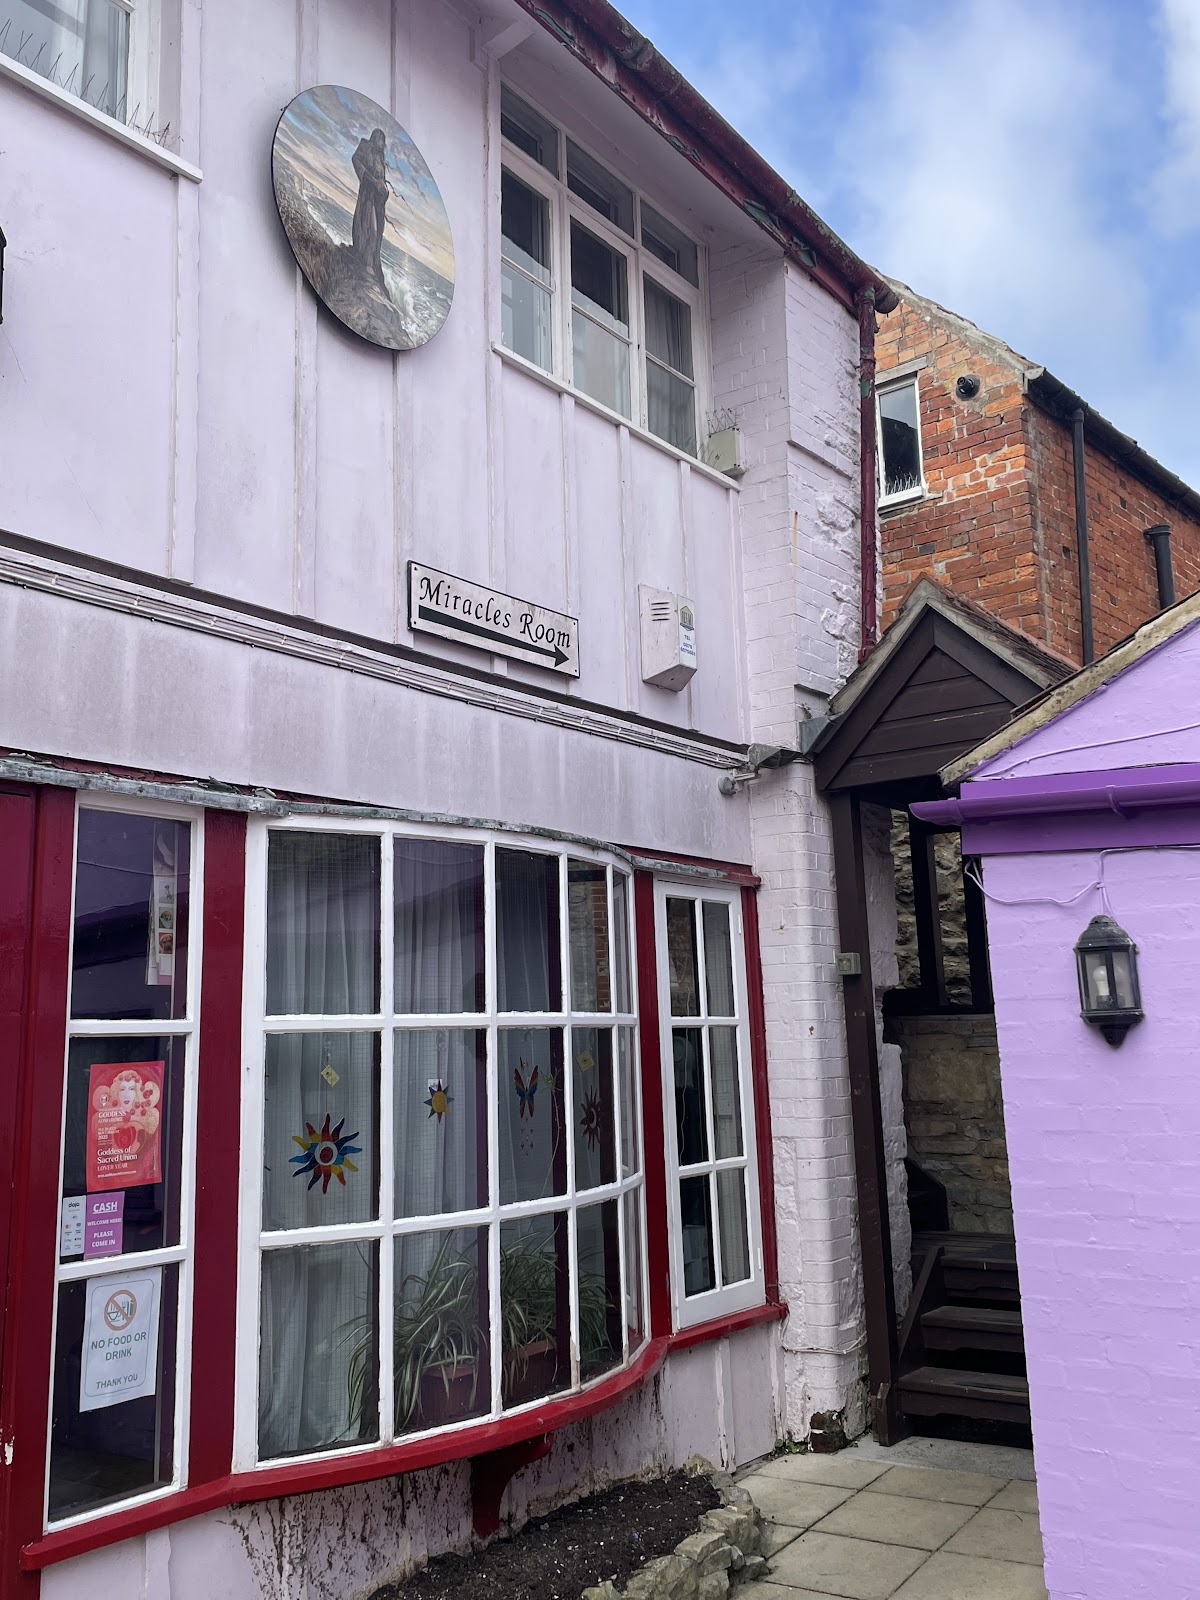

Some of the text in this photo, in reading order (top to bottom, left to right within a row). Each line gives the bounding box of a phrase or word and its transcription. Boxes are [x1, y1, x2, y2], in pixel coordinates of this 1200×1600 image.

[419, 576, 571, 648] Miracles Room
[97, 1145, 132, 1156] Goddess of
[97, 1155, 119, 1164] Sacred
[115, 1162, 128, 1170] YEAR
[93, 1202, 118, 1213] CASH
[93, 1230, 113, 1238] PLEASE
[91, 1240, 108, 1248] COME
[91, 1331, 147, 1350] NO FOOD OR
[105, 1348, 132, 1361] DRINK
[96, 1373, 138, 1390] THANK YOU
